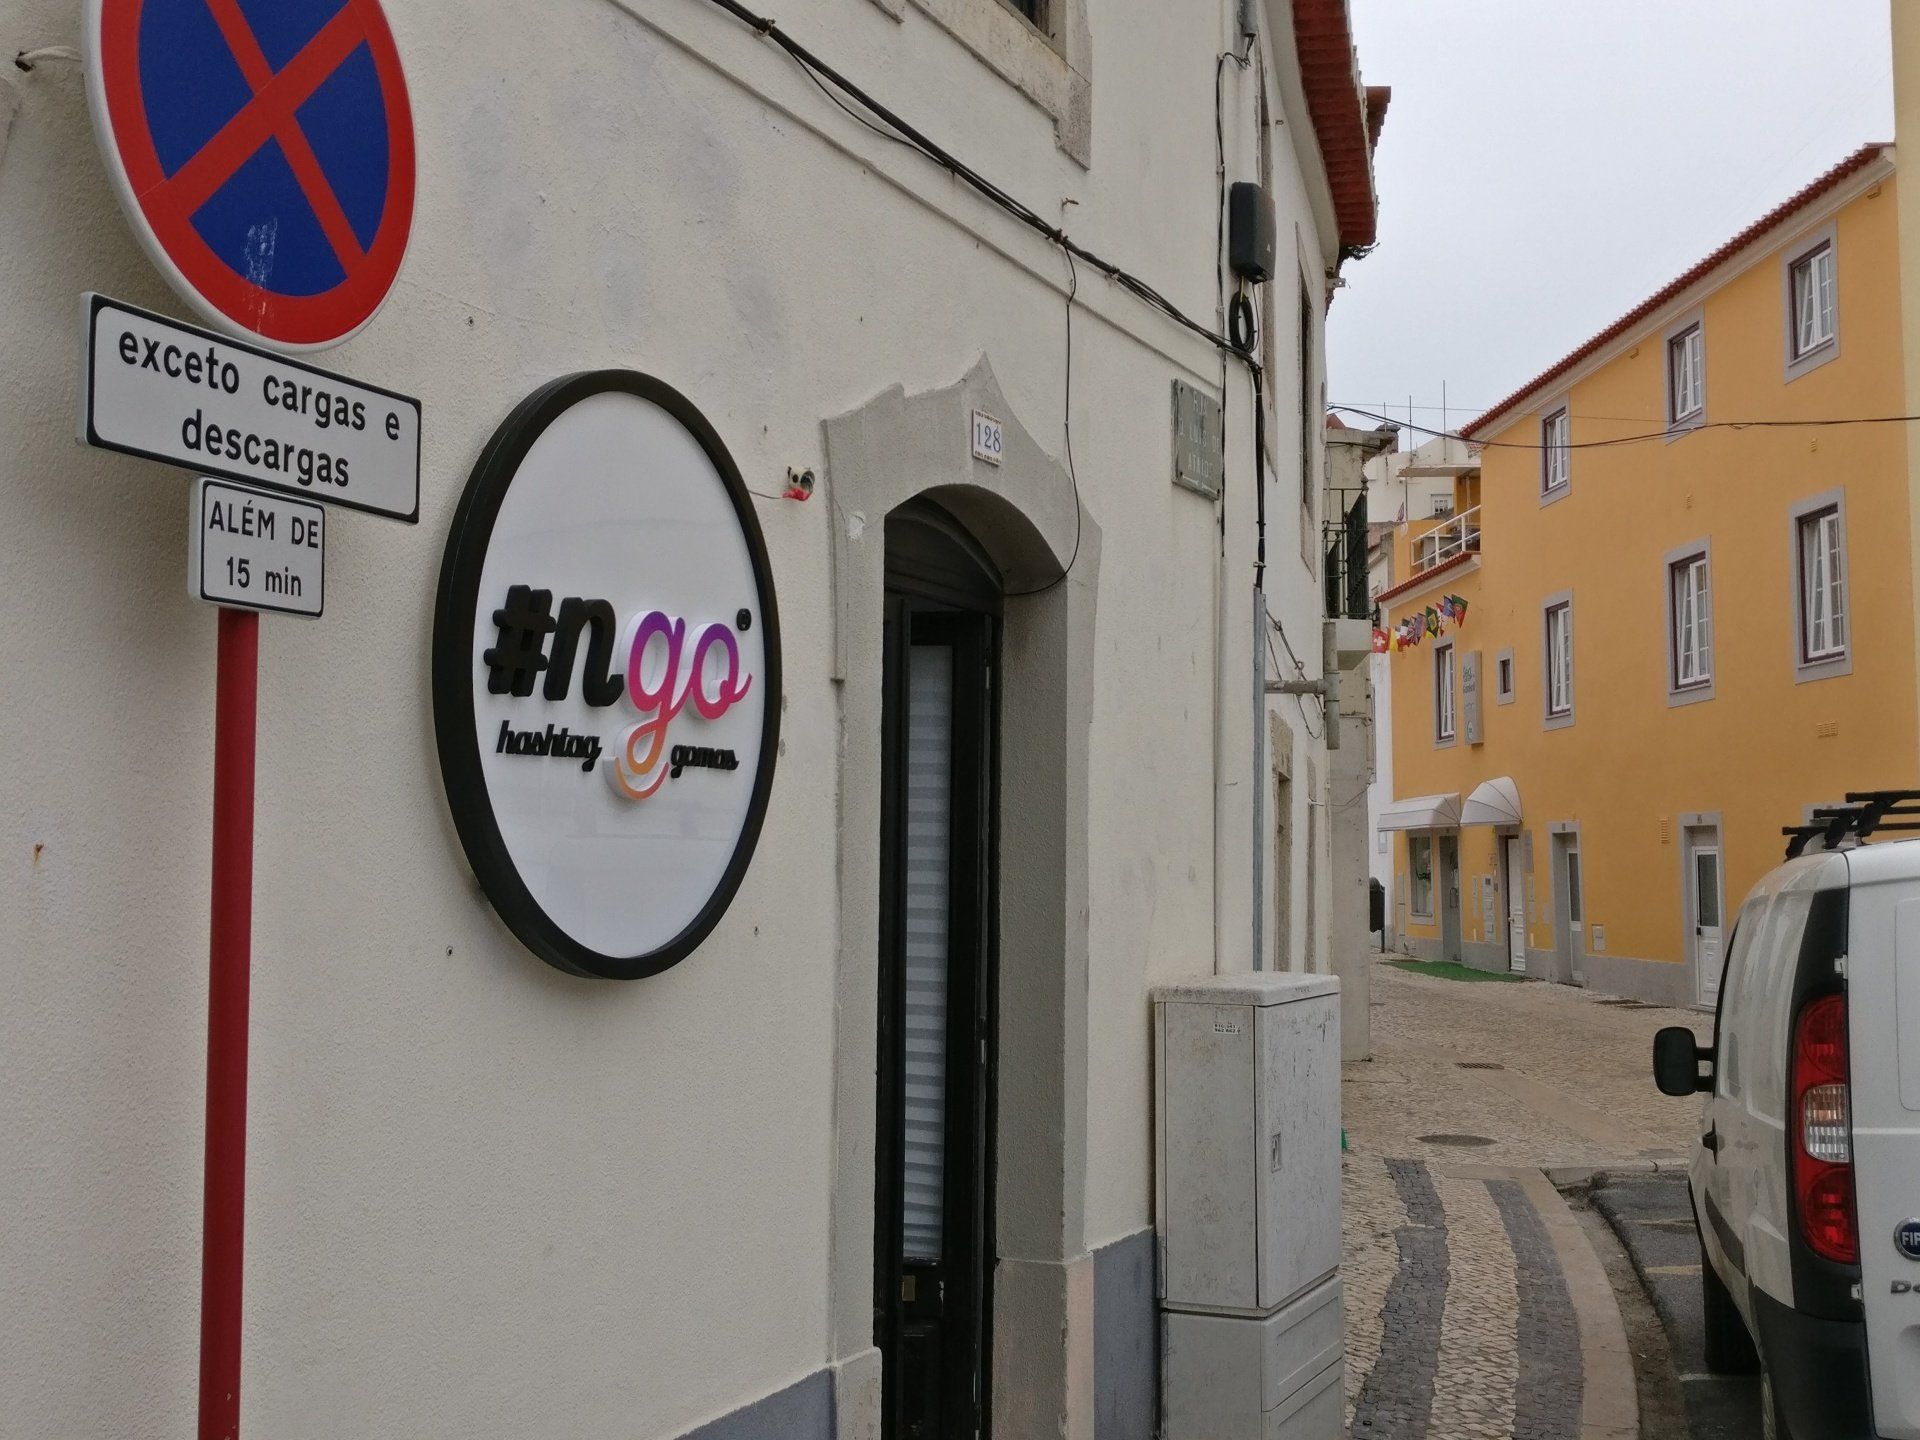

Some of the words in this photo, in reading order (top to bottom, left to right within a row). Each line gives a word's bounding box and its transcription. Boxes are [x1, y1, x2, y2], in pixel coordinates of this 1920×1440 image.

[118, 330, 240, 395] exceto
[262, 374, 367, 432] cargas
[385, 411, 401, 442] e
[182, 408, 350, 488] descargas
[976, 421, 1002, 453] 128
[208, 500, 276, 541] ALÉM
[291, 515, 319, 549] DE
[226, 556, 250, 589] 15
[265, 567, 302, 597] min
[496, 720, 602, 772] hashtag
[670, 744, 740, 779] gomas
